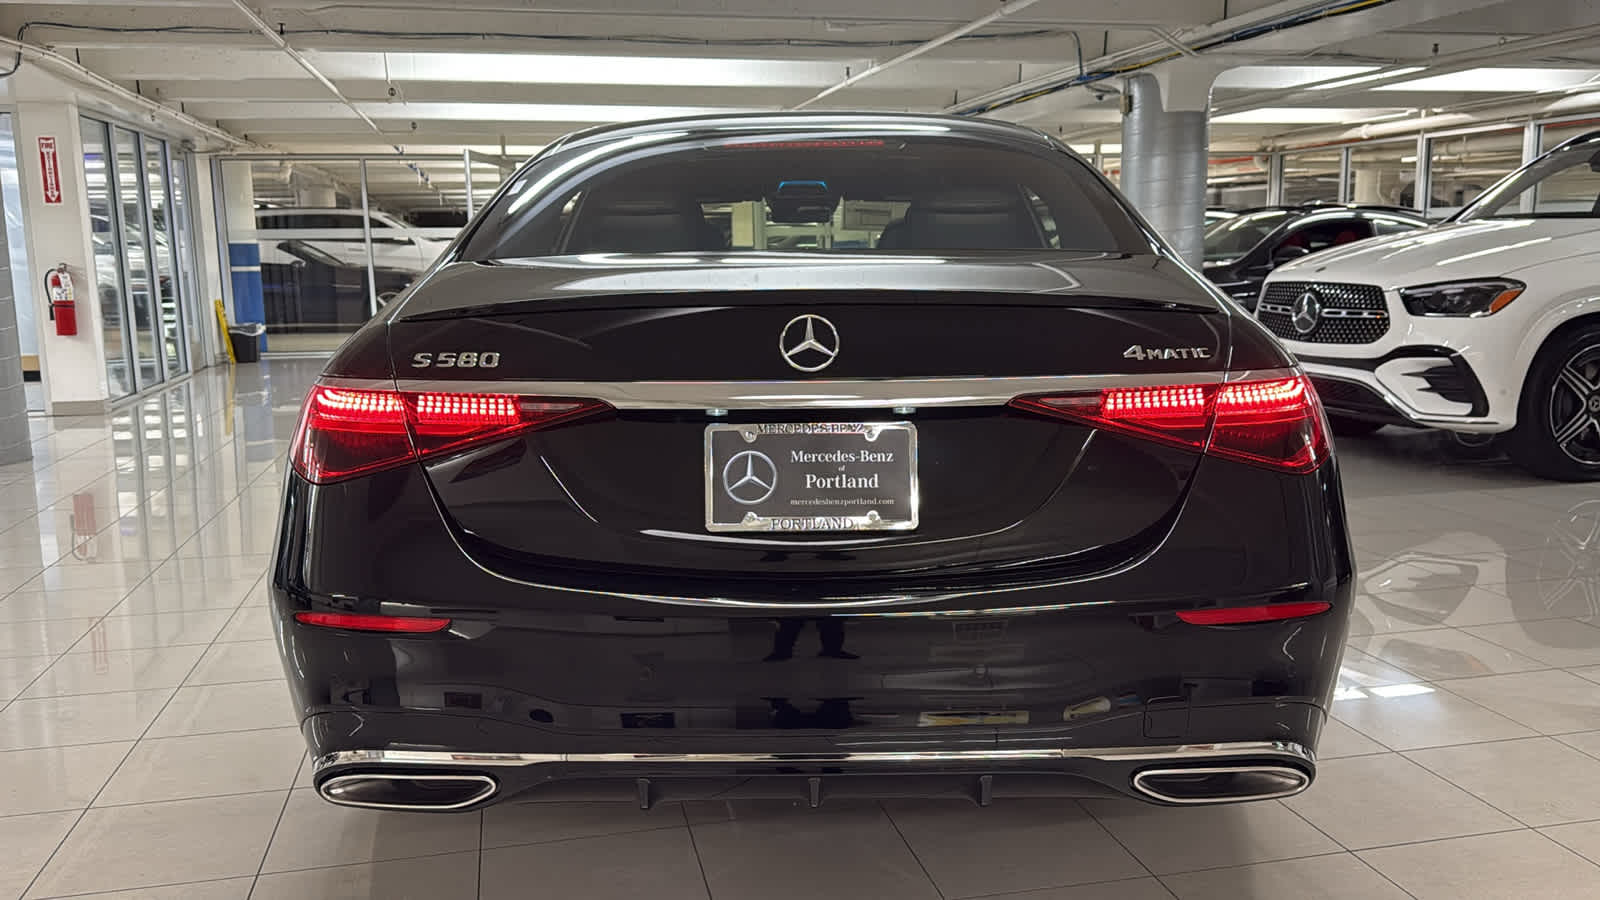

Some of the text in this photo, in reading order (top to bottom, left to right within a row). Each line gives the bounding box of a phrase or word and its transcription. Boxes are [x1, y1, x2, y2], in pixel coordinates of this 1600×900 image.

[1123, 345, 1211, 360] 4MATIC
[411, 352, 500, 367] S 580
[757, 423, 865, 433] MERCEDES-BENZ
[791, 450, 894, 463] Mercedes-Benz
[838, 464, 846, 472] of
[806, 473, 880, 489] Portland
[790, 497, 895, 507] mercedesbenzportland.com
[769, 517, 854, 530] PORTLAND
